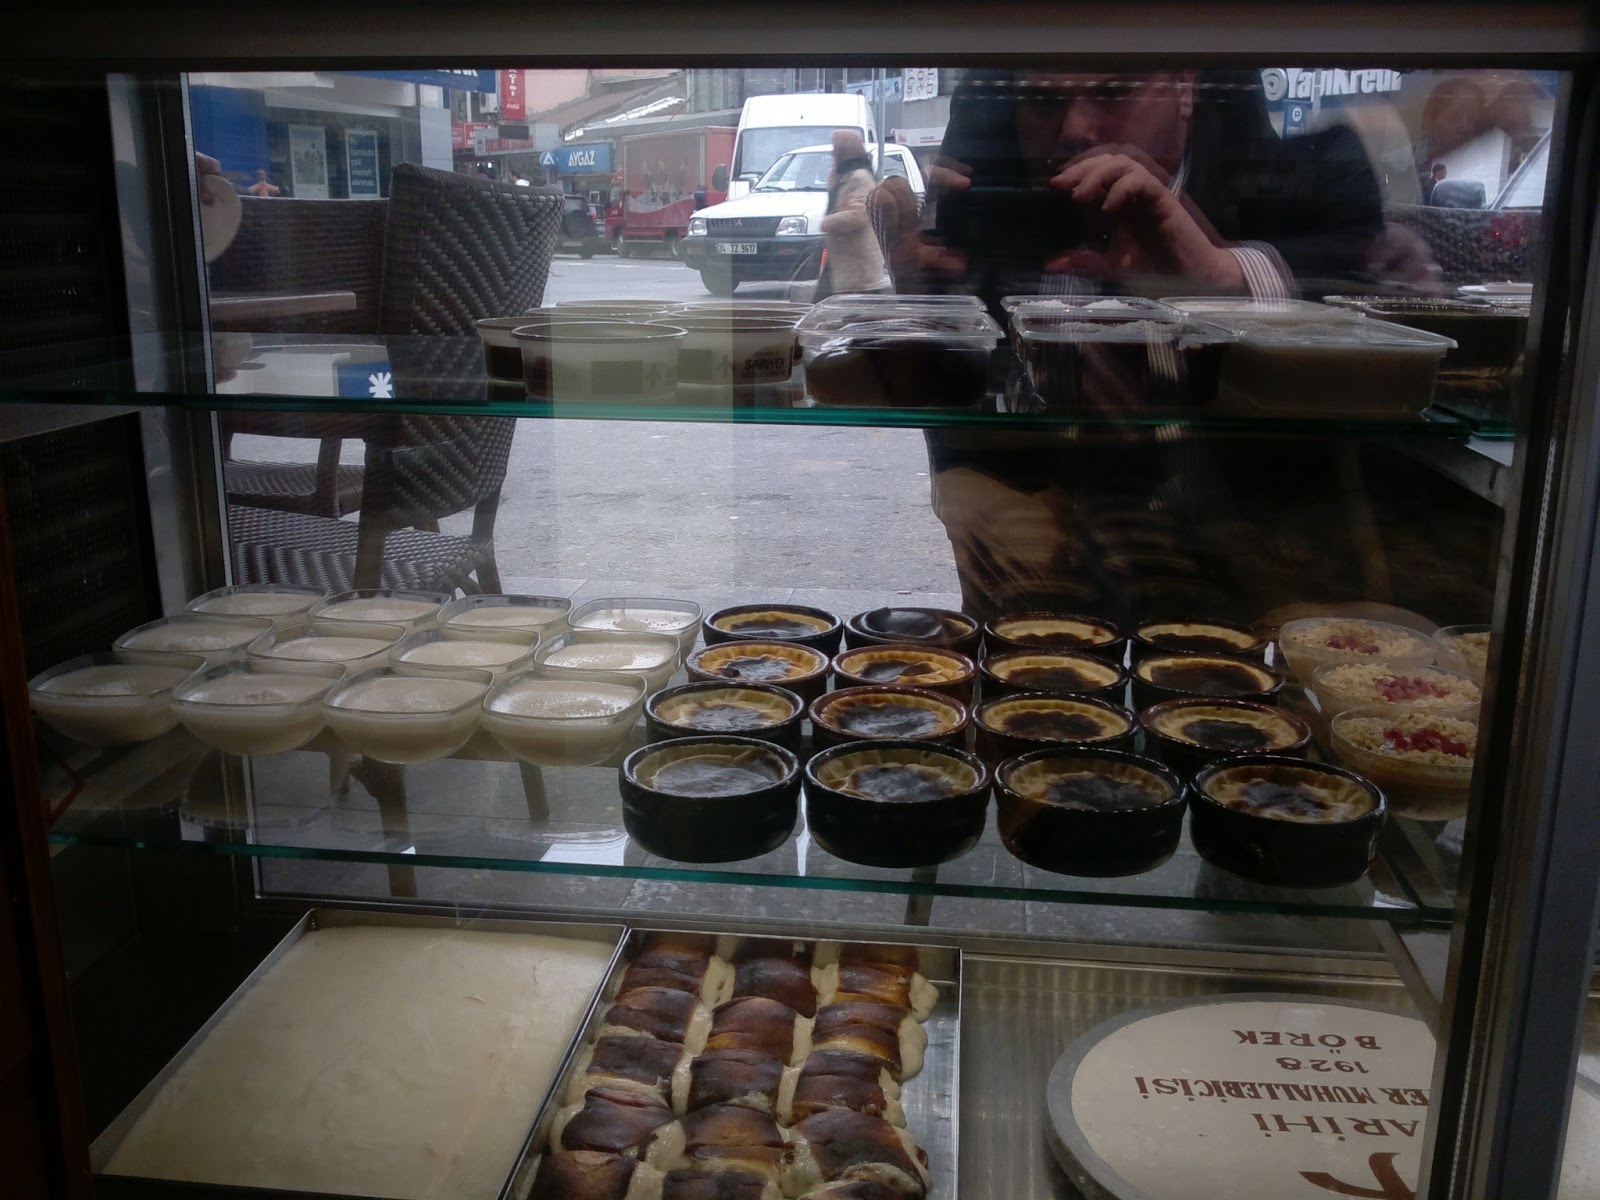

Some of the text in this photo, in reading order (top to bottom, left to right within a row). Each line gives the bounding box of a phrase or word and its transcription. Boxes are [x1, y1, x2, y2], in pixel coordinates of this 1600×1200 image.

[568, 150, 596, 167] AYGAZ
[730, 244, 739, 253] TZ
[741, 244, 756, 253] 9617
[1231, 1029, 1382, 1054] BÖREK
[1275, 1056, 1370, 1074] 1928
[1378, 1087, 1429, 1106] ER
[1250, 1112, 1420, 1142] ARİHİ
